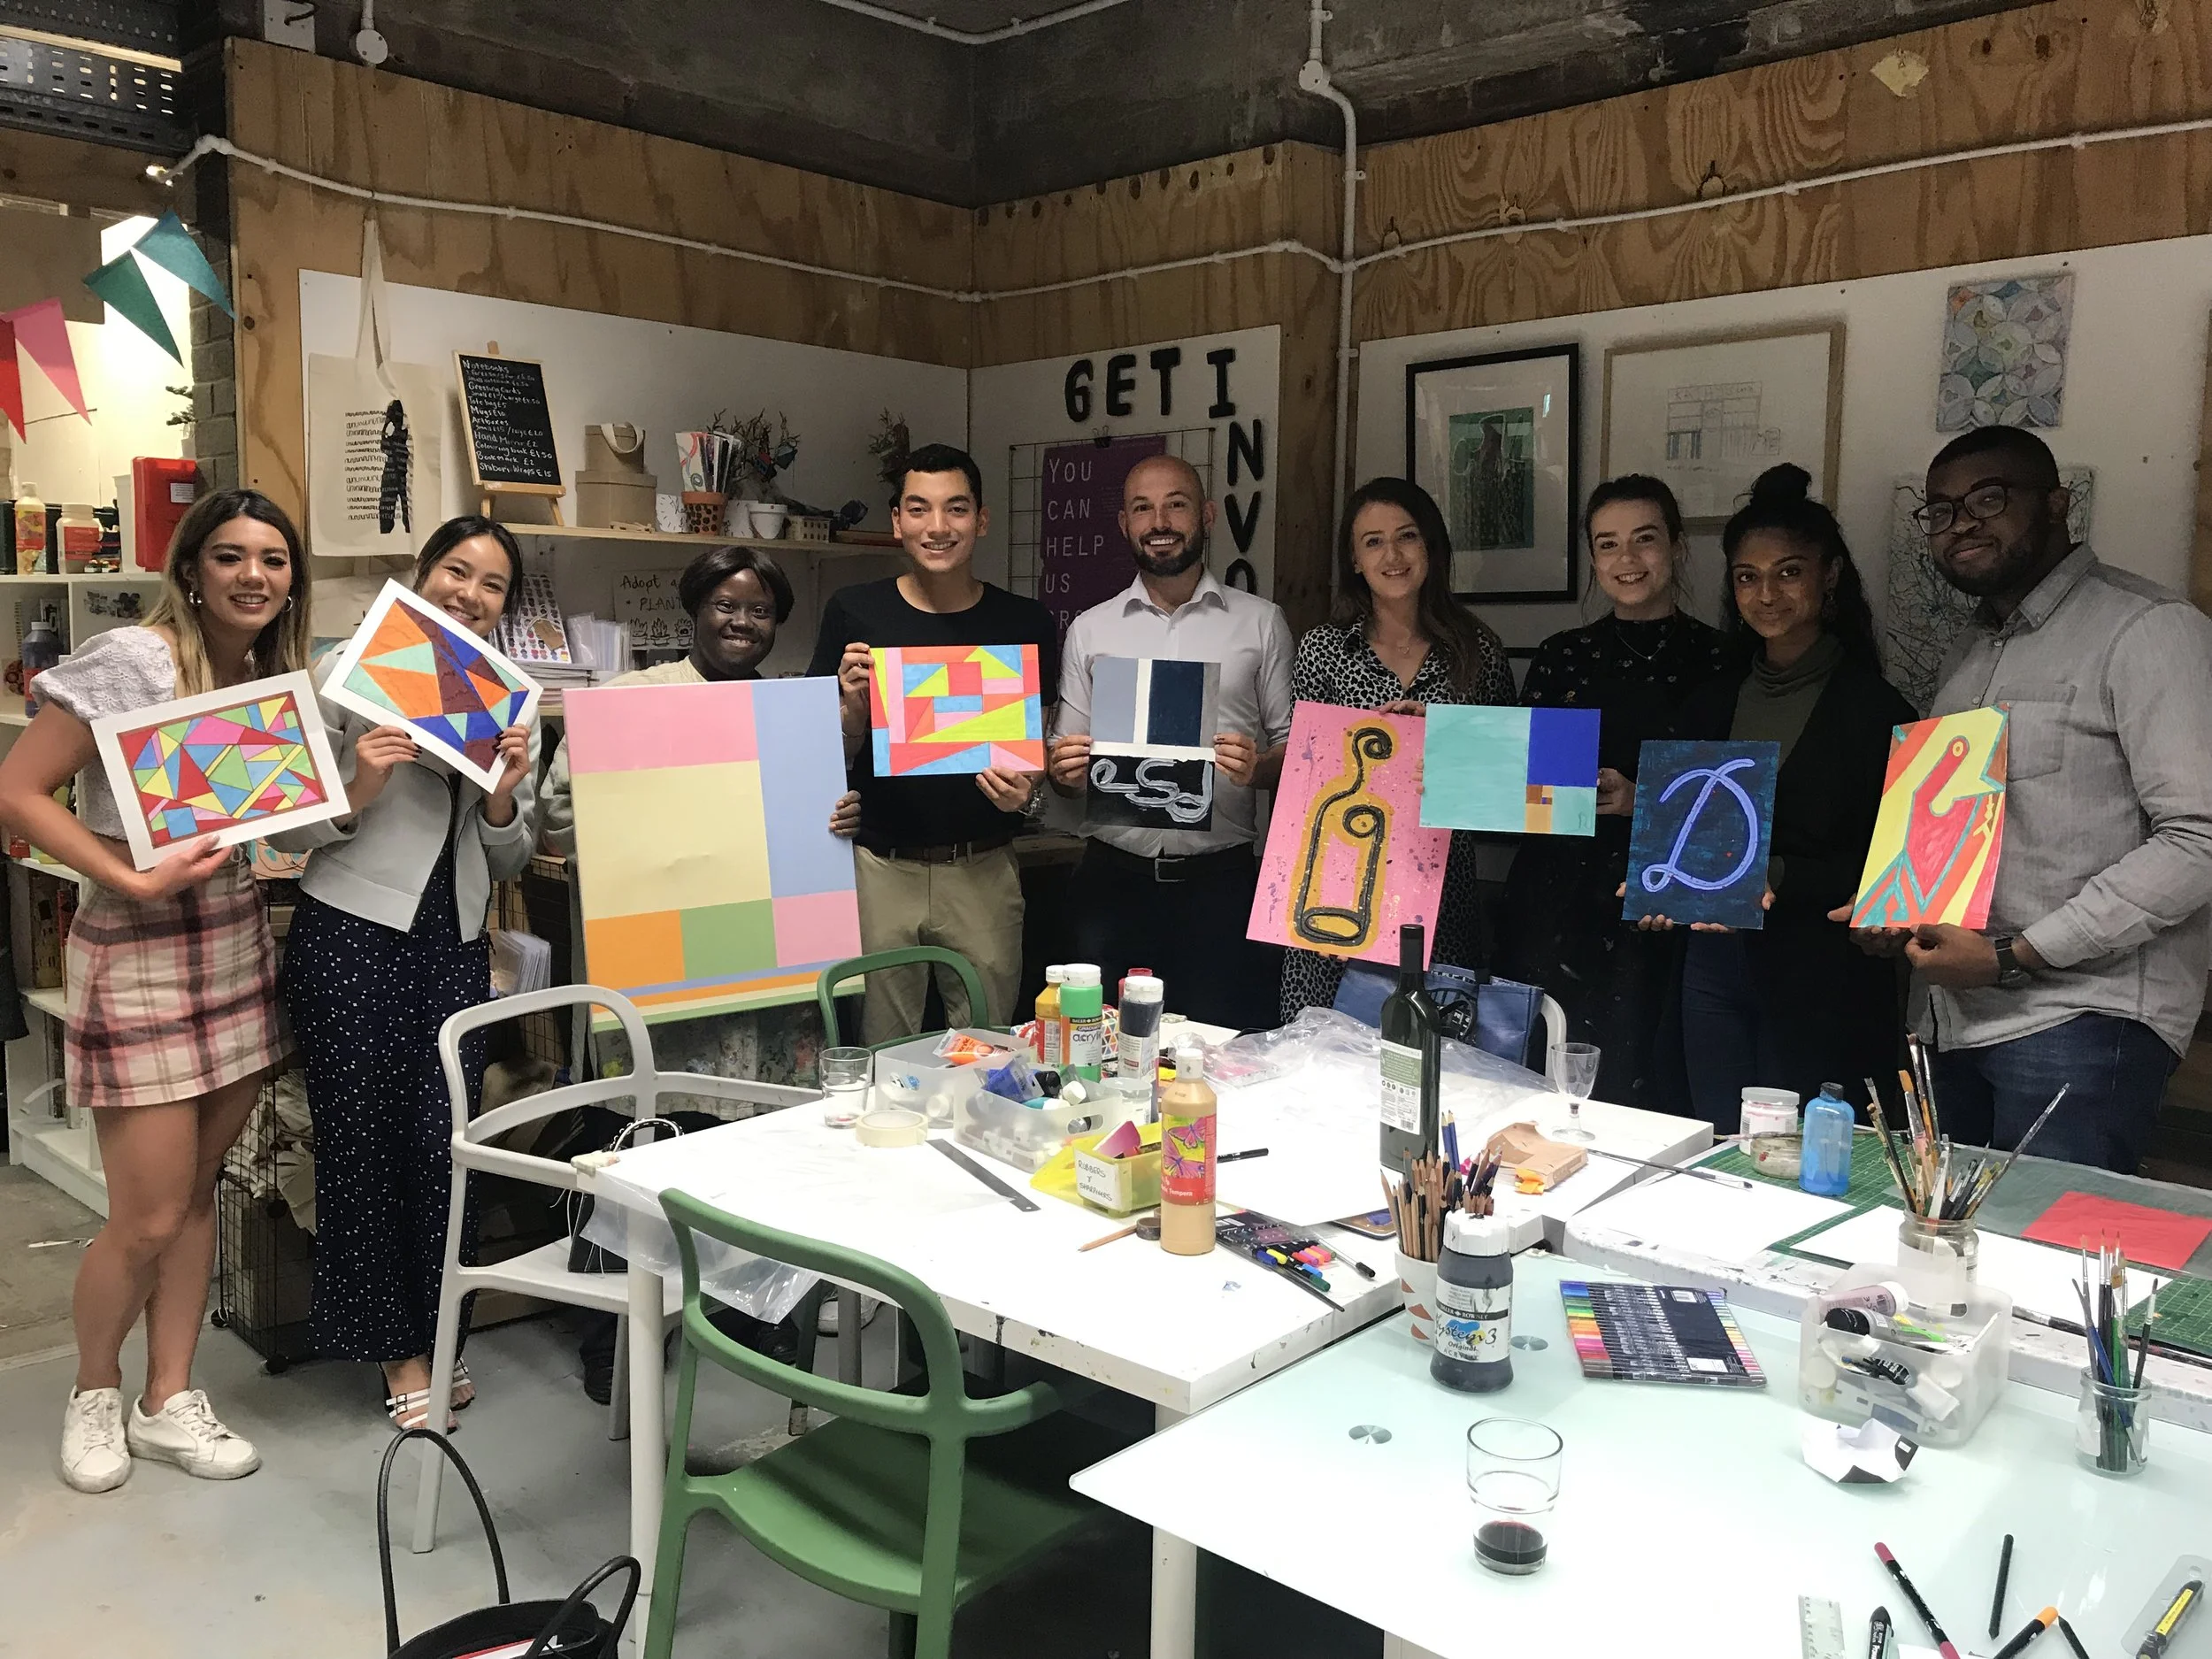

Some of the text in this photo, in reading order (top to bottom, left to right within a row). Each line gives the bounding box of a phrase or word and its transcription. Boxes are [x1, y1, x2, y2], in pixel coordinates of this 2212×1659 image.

[462, 359, 509, 373] Notebooks
[468, 381, 500, 396] Greeting
[1064, 347, 1181, 422] GET
[468, 396, 483, 405] Tote
[470, 405, 492, 419] Mugs
[473, 430, 497, 442] Hand
[475, 441, 511, 457] Colouring
[1048, 458, 1093, 483] YOU
[1047, 497, 1091, 521] CAN
[1046, 534, 1105, 557] HELP
[619, 574, 662, 595] Adopt
[1045, 572, 1071, 594] US
[1078, 1159, 1106, 1179] RUBBERS
[1169, 1187, 1194, 1198] Tempera
[1484, 1327, 1498, 1345] 3
[1448, 1340, 1479, 1353] Original
